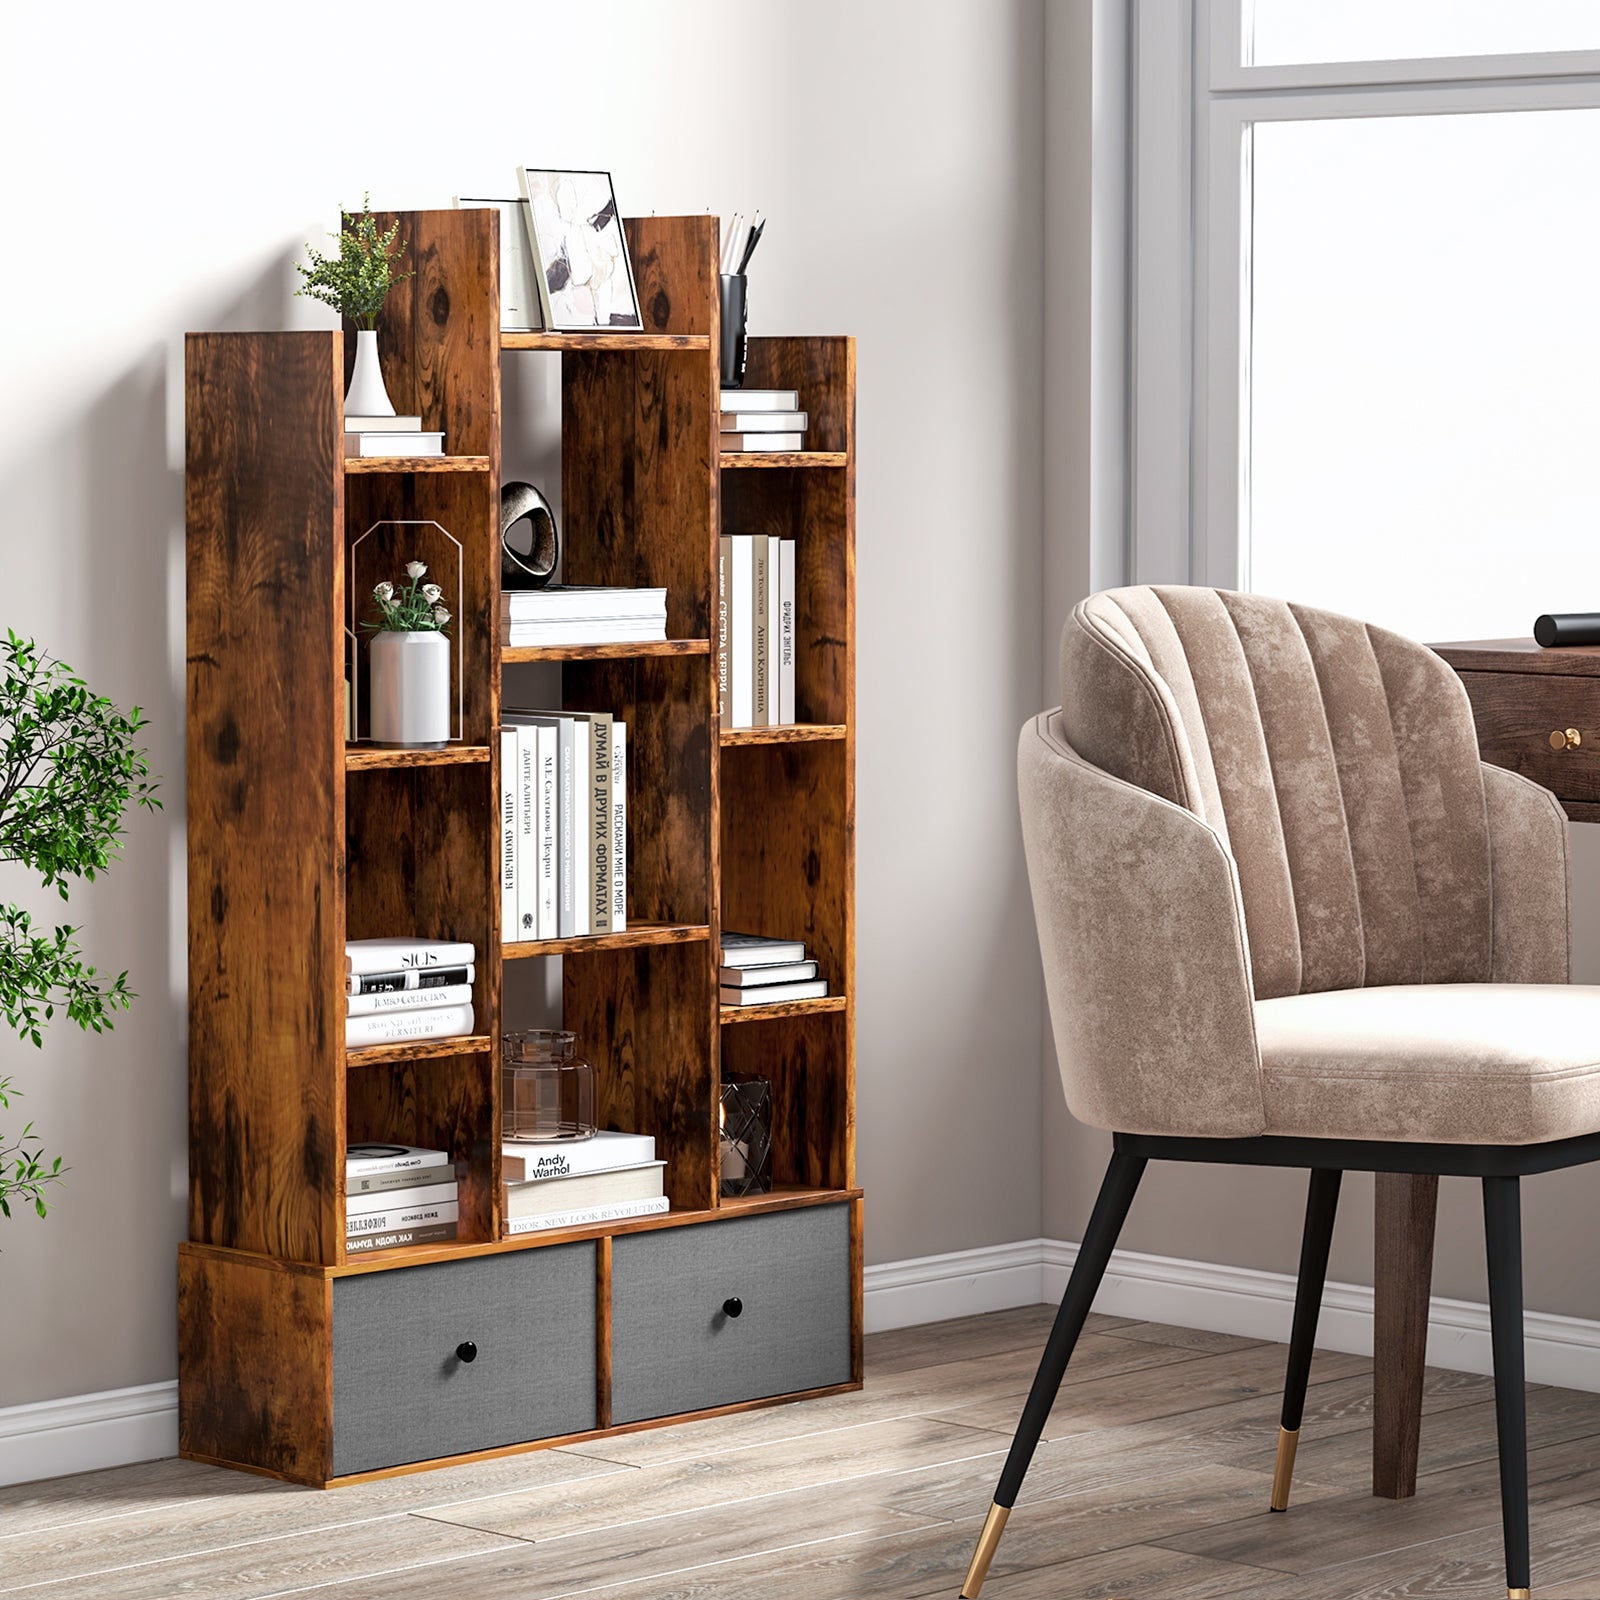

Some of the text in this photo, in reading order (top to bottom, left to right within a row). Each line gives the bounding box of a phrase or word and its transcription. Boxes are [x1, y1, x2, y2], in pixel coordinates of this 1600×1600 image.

[782, 601, 792, 666] ФРИДРИХ ЭНГЕЛЬС
[594, 722, 610, 770] ДУМАЙ
[505, 792, 513, 824] МИРУ
[523, 748, 531, 834] ДАНТЕ АЛИГЬЕРИ
[595, 787, 607, 840] ДРУГИХ
[614, 804, 624, 855] РАССКАЖИ
[505, 828, 513, 879] ВЕЧНОМУ
[614, 858, 624, 877] МНЕ
[596, 844, 607, 915] ФОРМАТАХ
[614, 890, 624, 915] МОРЕ
[402, 952, 438, 968] SICIS
[532, 1163, 570, 1178] Warhol
[537, 1154, 565, 1167] Andy
[544, 1216, 568, 1227] NEW
[570, 1213, 599, 1224] LOOK
[601, 1202, 666, 1219] REVOLUTION
